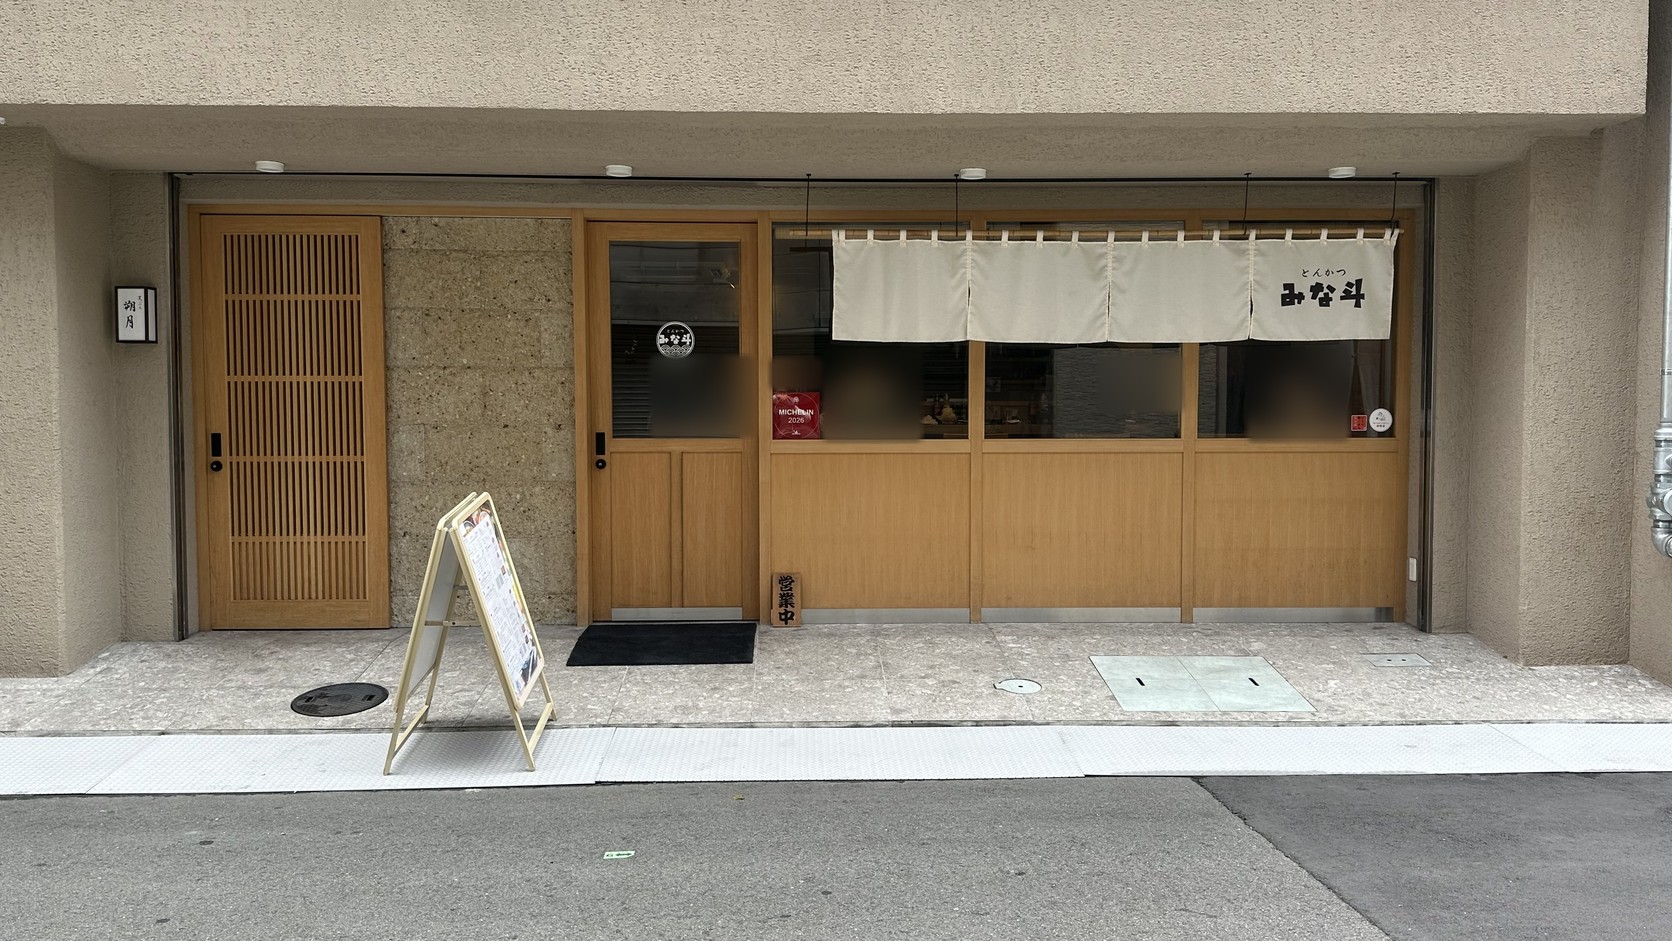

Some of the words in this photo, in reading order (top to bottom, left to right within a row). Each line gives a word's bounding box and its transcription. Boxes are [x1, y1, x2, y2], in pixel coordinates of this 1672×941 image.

[1301, 268, 1347, 278] とんかつ
[1280, 278, 1365, 308] みな斗
[123, 300, 136, 329] 朔月
[659, 334, 692, 345] みな斗
[778, 575, 795, 625] 営業中
